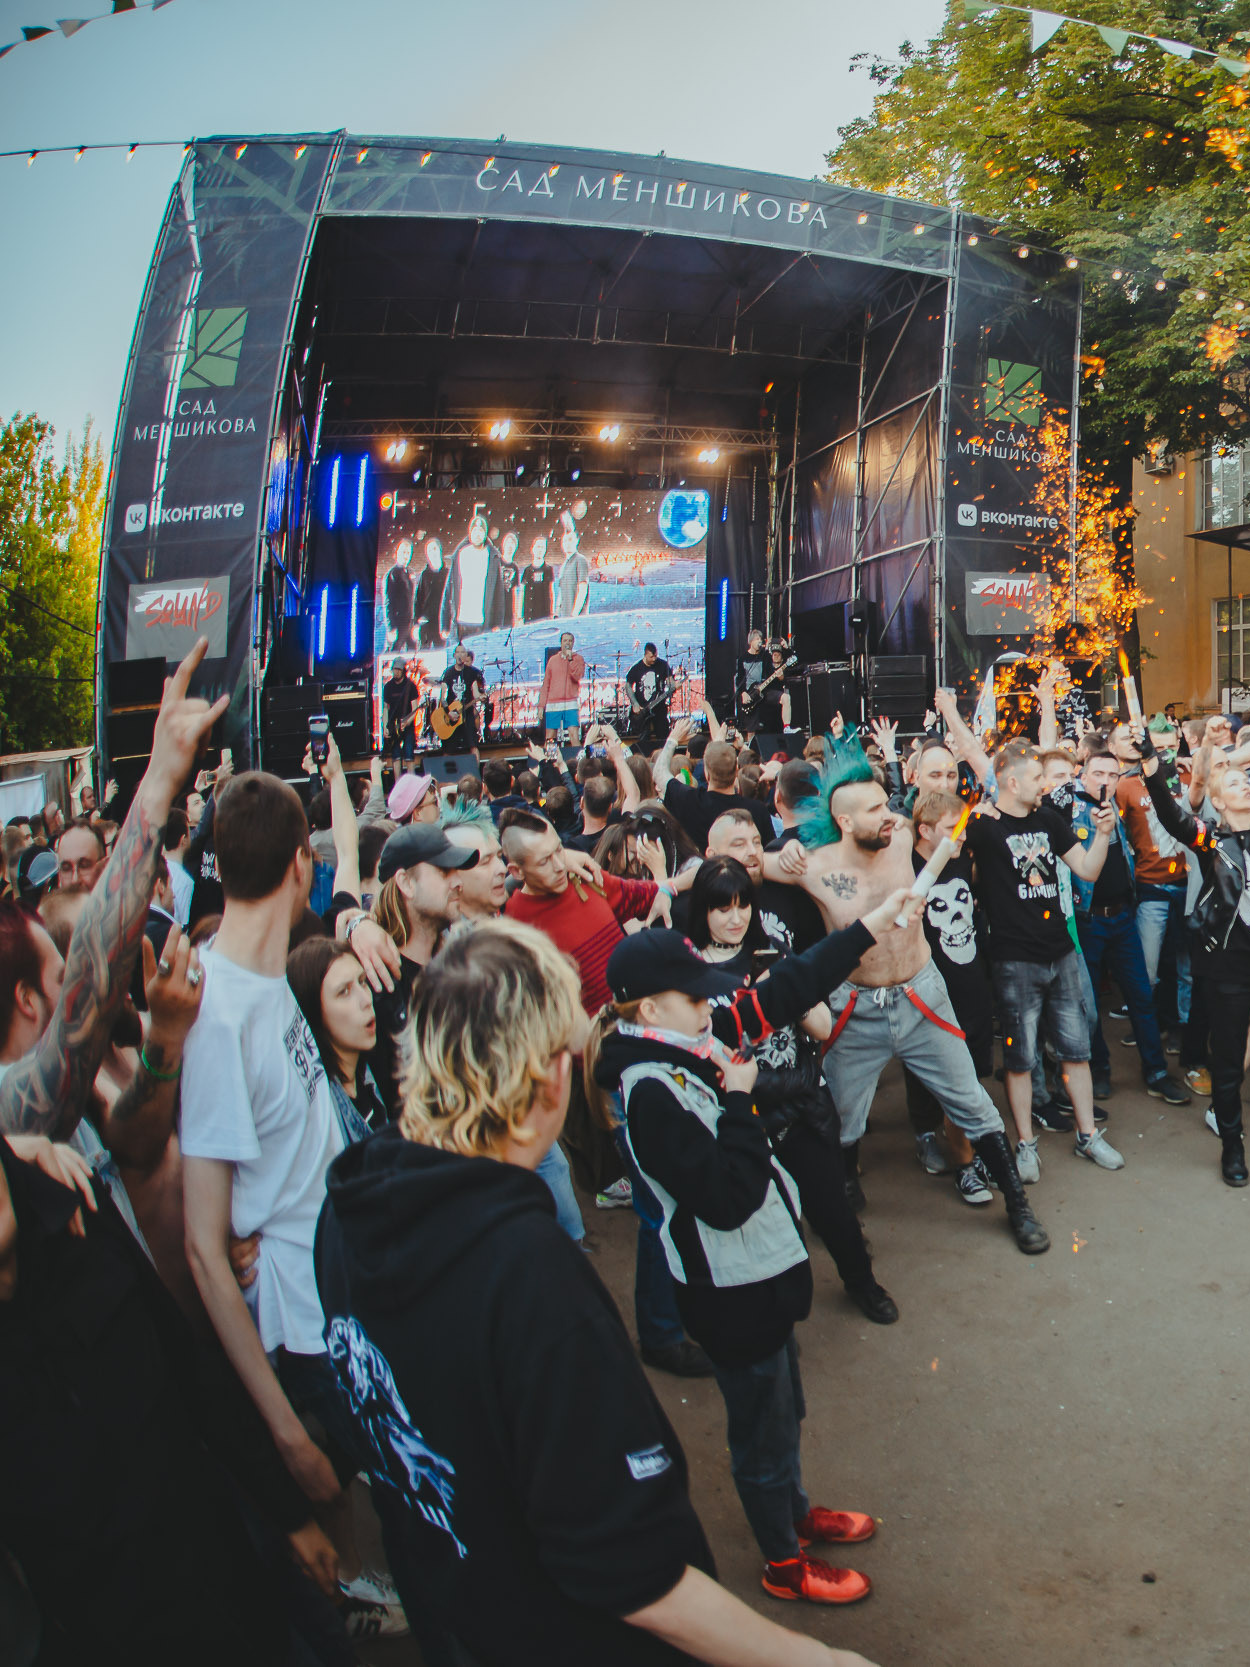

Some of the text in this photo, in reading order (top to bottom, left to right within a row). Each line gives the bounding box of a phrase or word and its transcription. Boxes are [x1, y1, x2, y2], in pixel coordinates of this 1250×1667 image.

[476, 167, 829, 229] САД МЕНШИКОВА
[178, 399, 217, 416] САД
[133, 417, 256, 441] МЕШИКОВА
[995, 430, 1028, 447] САД
[153, 502, 245, 524] контакте
